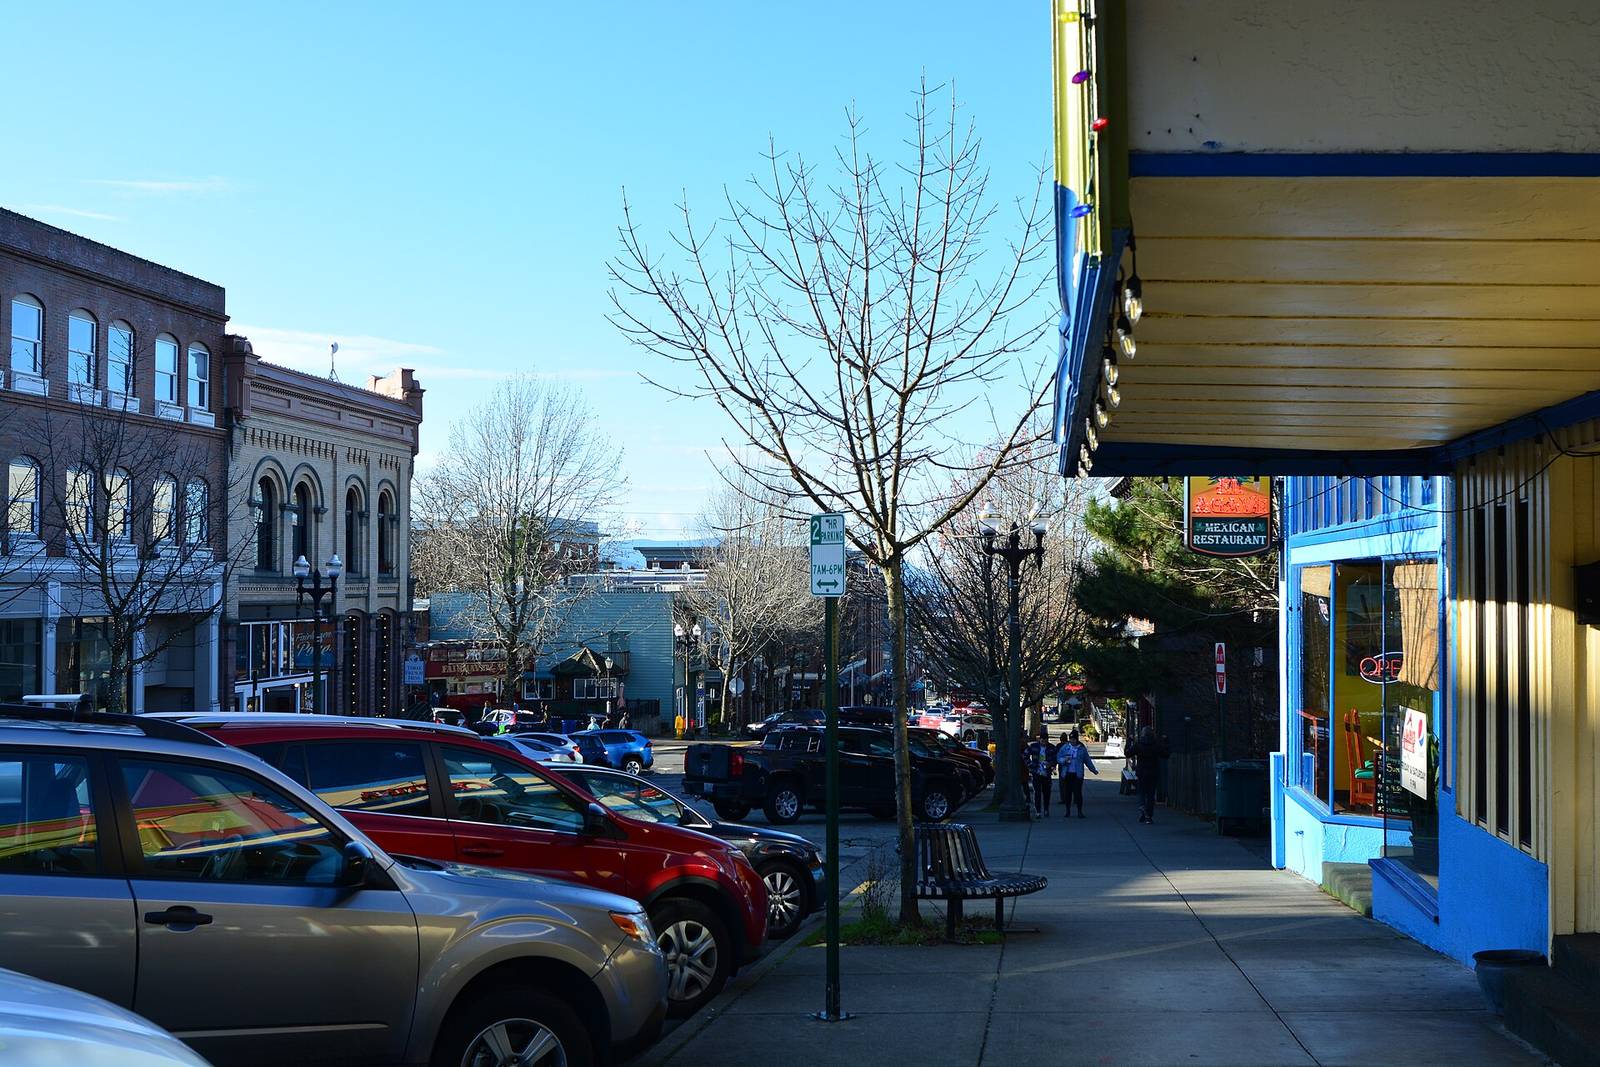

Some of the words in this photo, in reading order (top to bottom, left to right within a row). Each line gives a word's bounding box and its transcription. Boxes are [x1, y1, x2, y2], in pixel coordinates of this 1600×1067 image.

[812, 521, 820, 540] 2
[828, 519, 838, 528] HR
[1205, 522, 1255, 532] MEXICAN
[821, 531, 843, 541] PARKING
[1193, 535, 1267, 544] RESTAURANT
[813, 564, 843, 574] 7AM-6PM
[1360, 657, 1401, 678] OPE
